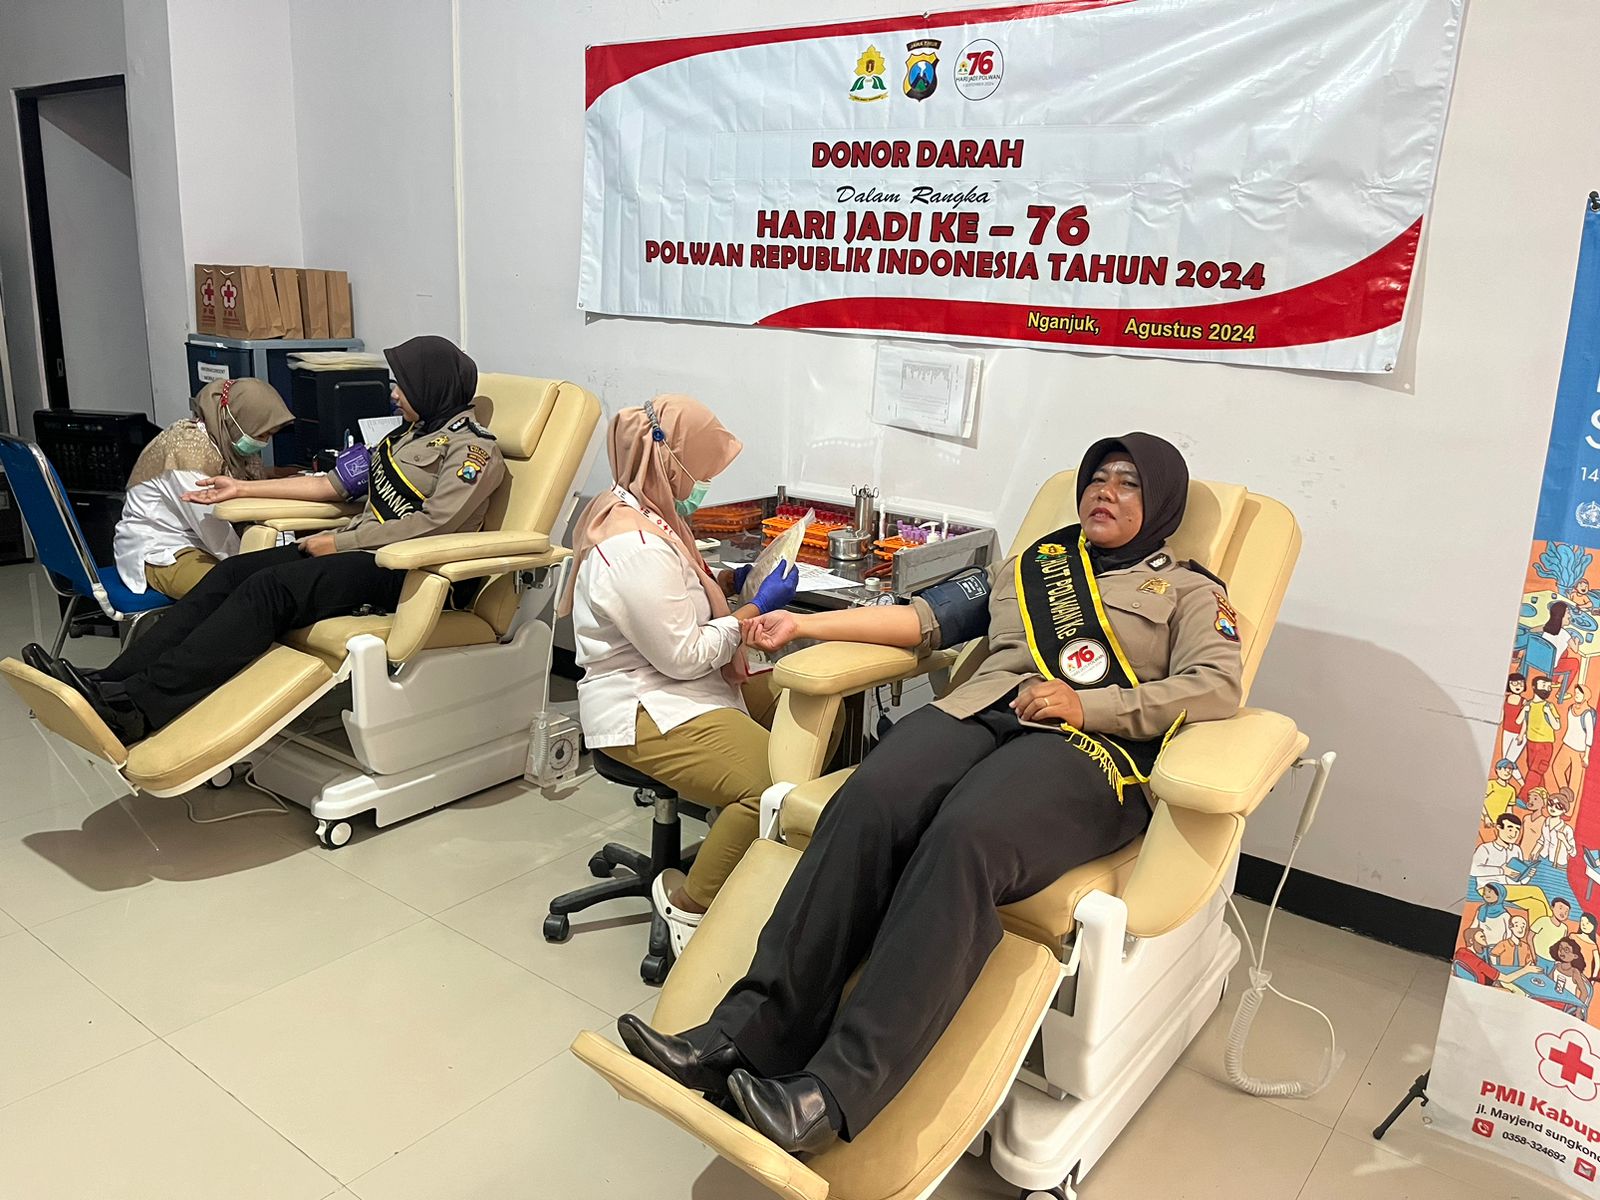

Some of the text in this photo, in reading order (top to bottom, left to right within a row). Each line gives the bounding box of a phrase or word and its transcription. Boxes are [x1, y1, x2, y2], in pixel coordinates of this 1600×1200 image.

[966, 50, 994, 75] 76
[812, 139, 1024, 168] DONOR DARAH
[836, 186, 991, 209] Dalam Rangka
[757, 210, 836, 240] HARI
[843, 211, 922, 244] JADI
[930, 211, 979, 243] KE
[1027, 205, 1090, 246] 76
[645, 240, 1265, 290] POLWAN REPUBLIK INDONESIA TAHUN 2024
[1027, 311, 1256, 343] Nganjuk, Agustus 2024
[1581, 466, 1599, 482] 14
[1045, 577, 1082, 624] POLWAN
[1067, 645, 1095, 669] 76
[1476, 1103, 1487, 1114] jl.
[1490, 1107, 1543, 1132] Mayjend
[1480, 1080, 1600, 1143] PMI Kabup
[1502, 1131, 1566, 1163] 0358-324692
